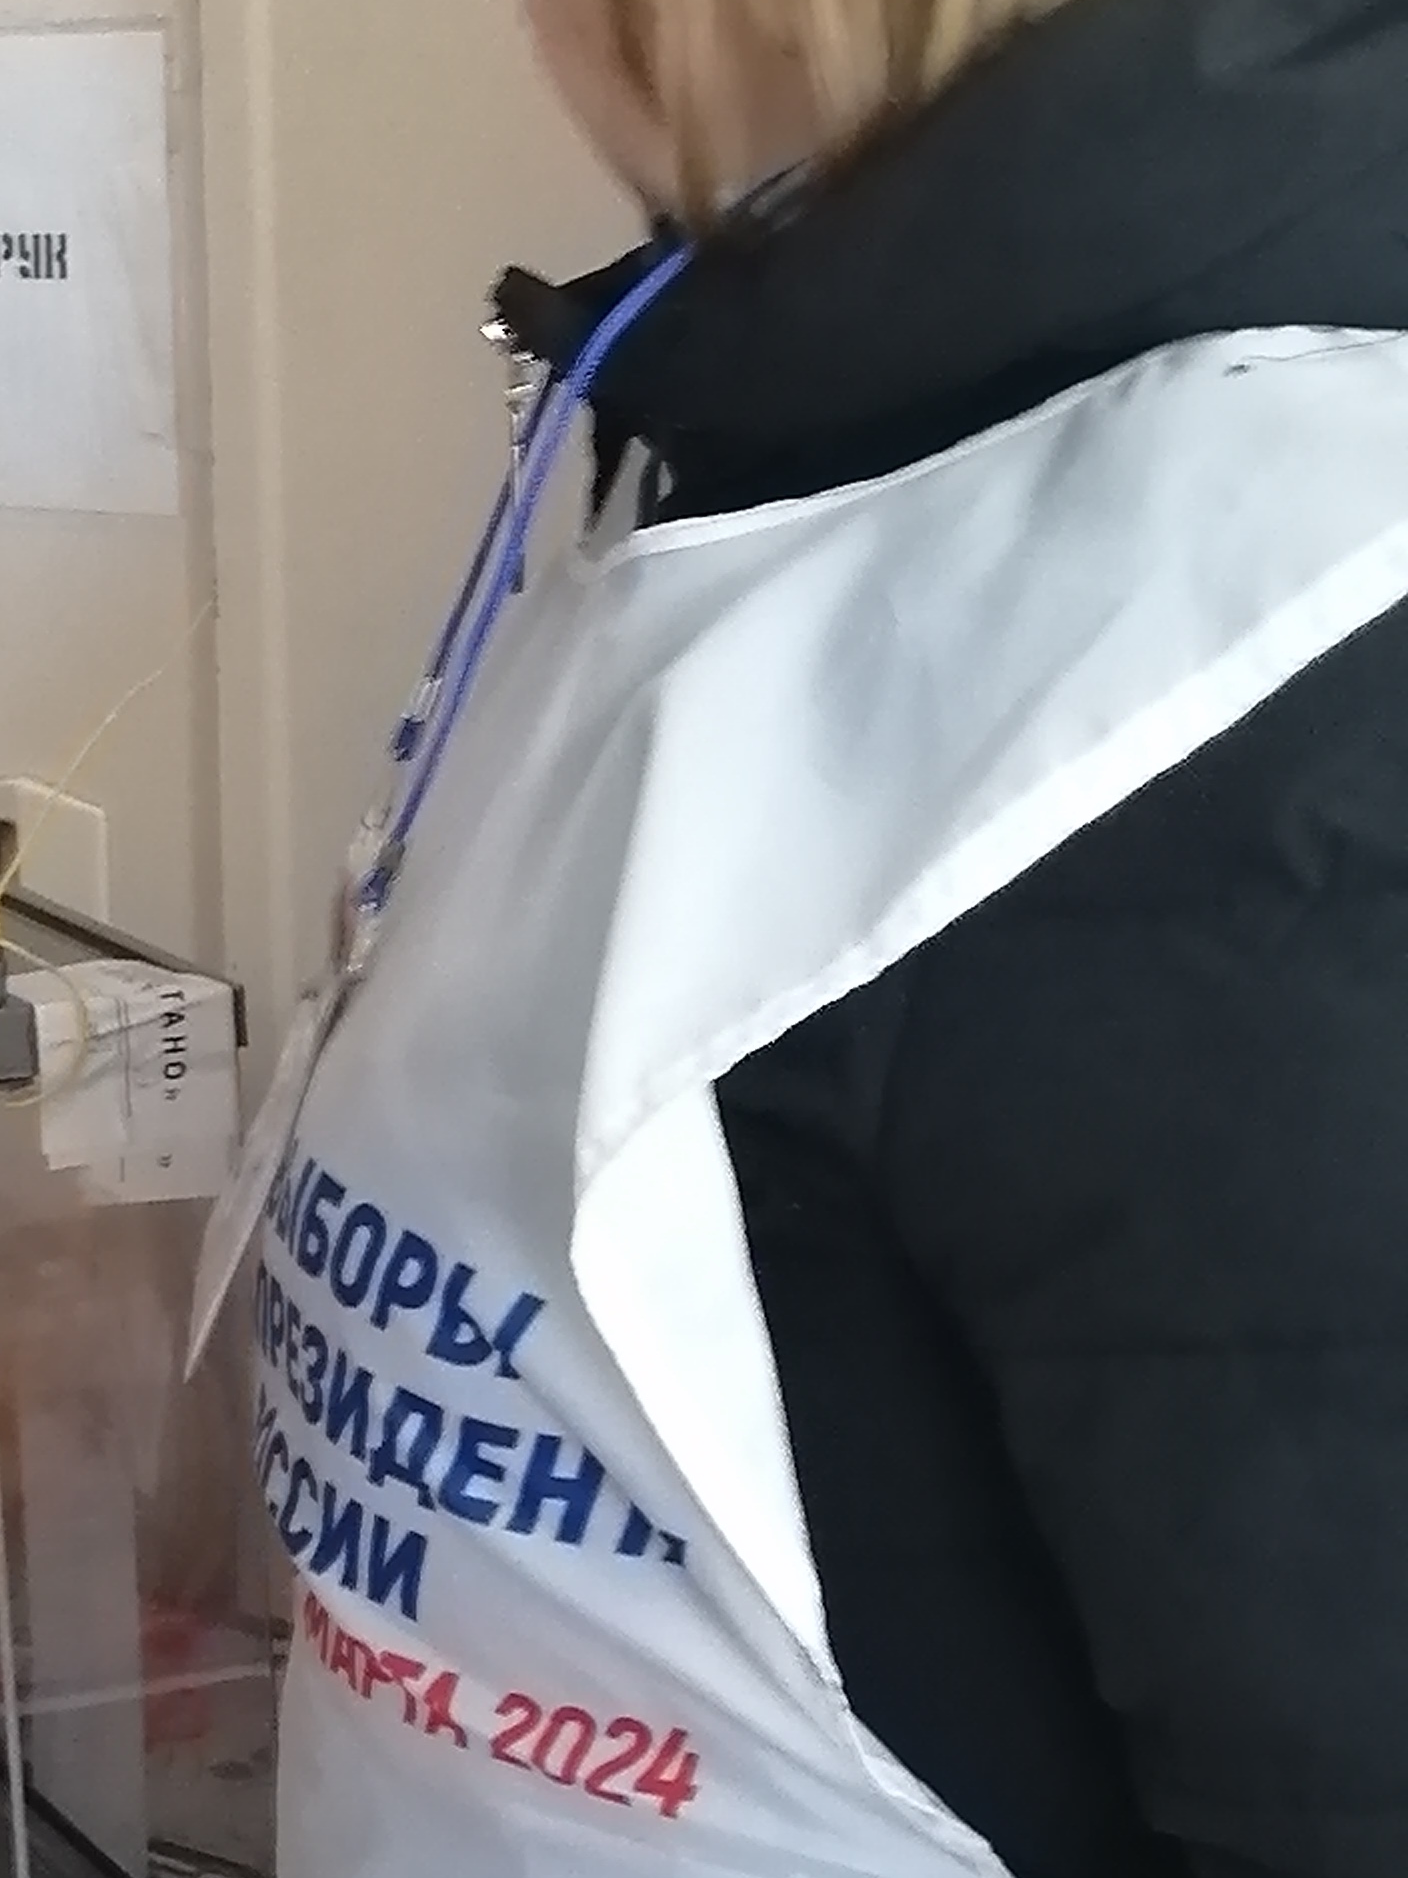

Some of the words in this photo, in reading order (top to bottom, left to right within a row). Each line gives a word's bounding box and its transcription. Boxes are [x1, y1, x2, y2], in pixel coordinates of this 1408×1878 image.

[256, 1260, 688, 1567] ПРЕЗИДЕН
[302, 1589, 469, 1749] МАРТА
[490, 1691, 702, 1819] 2024
